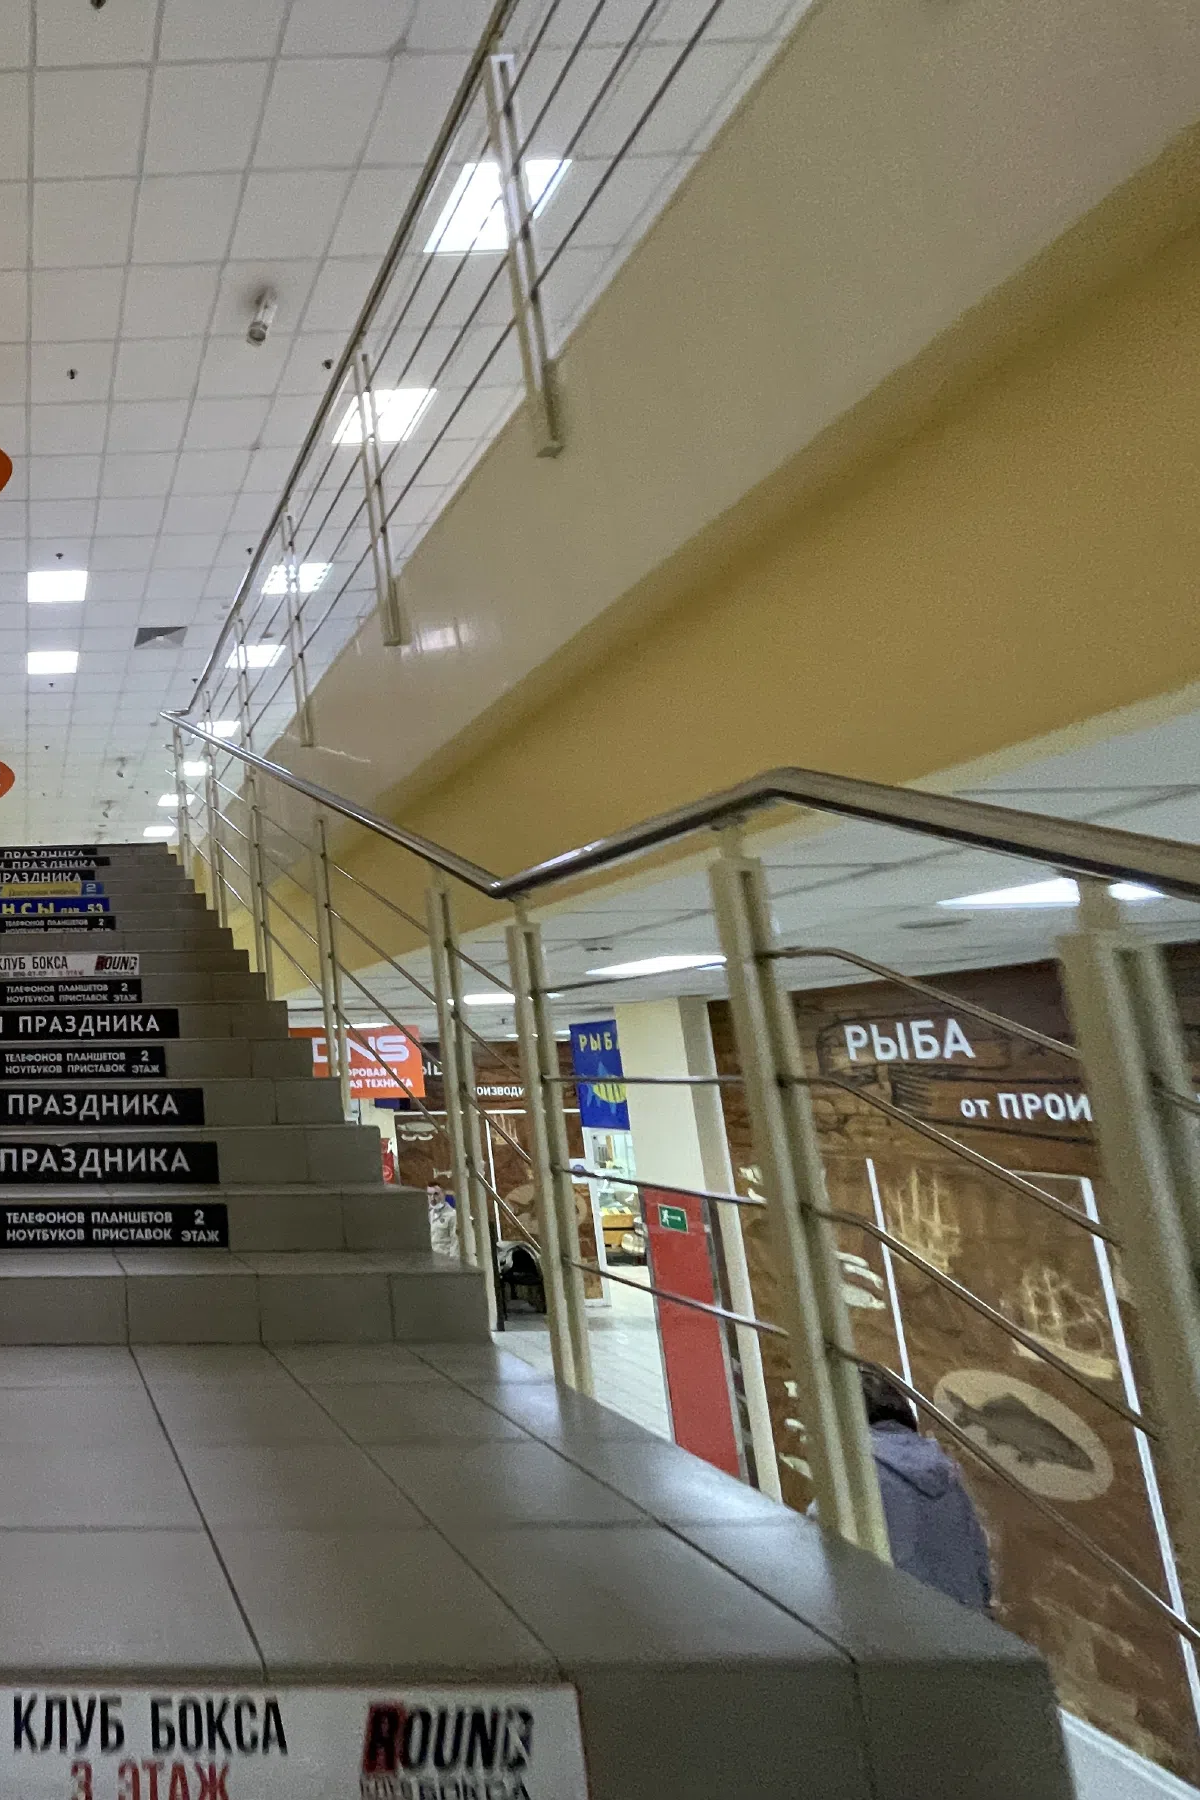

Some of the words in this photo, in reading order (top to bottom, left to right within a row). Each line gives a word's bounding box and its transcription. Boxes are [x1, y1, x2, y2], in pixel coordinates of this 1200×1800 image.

[32, 956, 69, 970] БОКСА
[6, 985, 55, 993] ТЕЛЕФОНОВ
[58, 984, 109, 992] ПЛАНШЕТОВ
[121, 982, 129, 992] 2
[6, 995, 55, 1004] НОУТБУКОВ
[59, 994, 109, 1003] ПРИСТАВОК
[113, 994, 138, 1002] ЭТАЖ
[18, 1014, 161, 1037] ПРАЗДНИКА
[312, 1034, 410, 1063] DNS
[844, 1018, 976, 1061] РЫБА
[5, 1053, 63, 1063] ТЕЛЕФОНОВ
[66, 1052, 126, 1062] ПЛАНШЕТОВ
[141, 1050, 149, 1062] 2
[5, 1065, 63, 1074] НОУТБУКОВ
[67, 1064, 126, 1073] ПРИСТАВОК
[131, 1065, 160, 1074] ЭТАЖ
[8, 1093, 179, 1121] ПРАЗДНИКА
[960, 1099, 990, 1119] от
[996, 1092, 1093, 1122] ПРОИ
[0, 1147, 191, 1178] ПРАЗДНИКА
[6, 1212, 85, 1225] ТЕЛЕФОНОВ
[91, 1211, 173, 1224] ПЛАНШЕТОВ
[194, 1209, 205, 1225] 2
[6, 1228, 85, 1241] НОУТБУКОВ
[92, 1227, 173, 1240] ПРИСТАВОК
[180, 1230, 220, 1242] ЭТАЖ
[12, 1693, 125, 1754] КЛУБ
[150, 1694, 289, 1756] БОКСА
[70, 1760, 93, 1800] 3
[117, 1759, 230, 1800] ЭТАЖ
